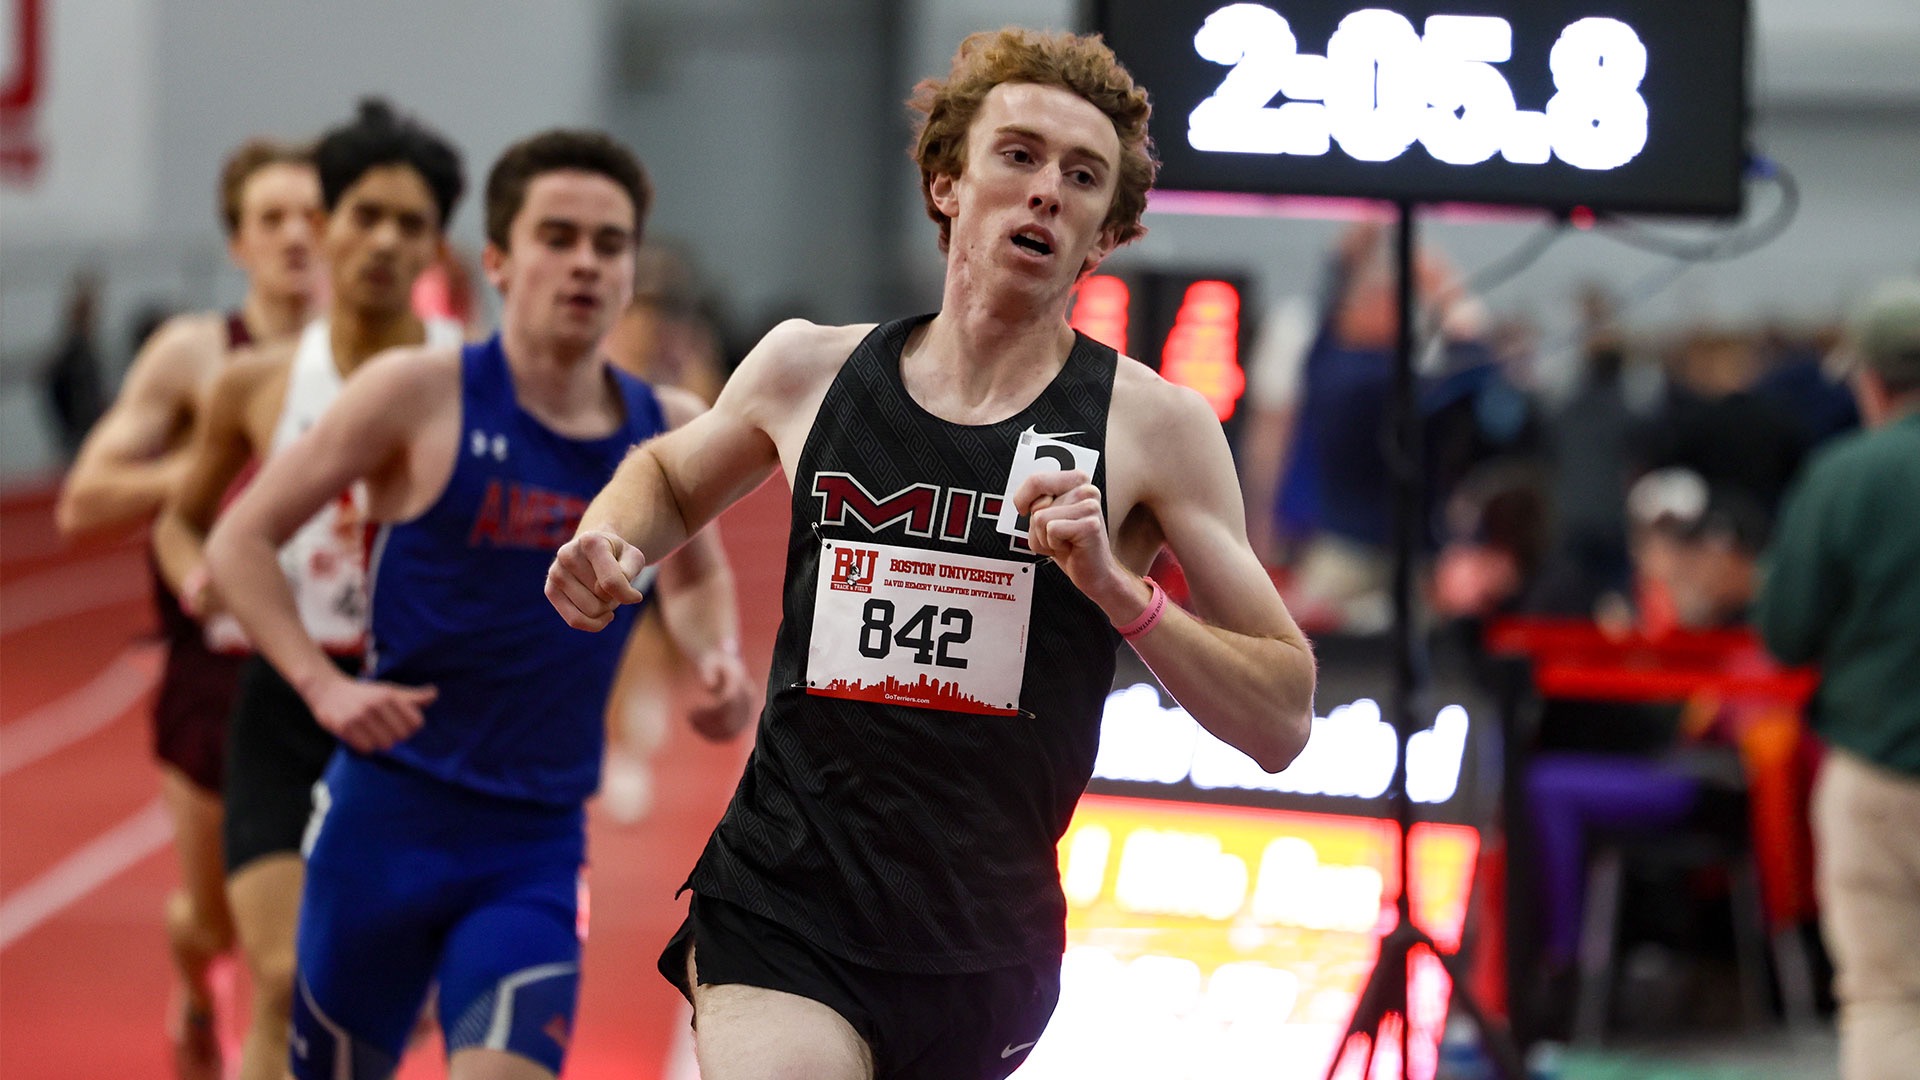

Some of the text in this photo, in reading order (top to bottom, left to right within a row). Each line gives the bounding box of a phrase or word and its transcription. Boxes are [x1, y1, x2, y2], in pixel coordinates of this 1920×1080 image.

[1188, 3, 1648, 171] 2:05.8
[831, 547, 879, 585] BU
[889, 558, 1015, 586] BOSTON UNIVERSITY
[883, 579, 1016, 602] DAVID HEMERY VALENTINE INVITATIONAL
[858, 598, 973, 669] 842
[884, 693, 930, 704] GoTerriers.com
